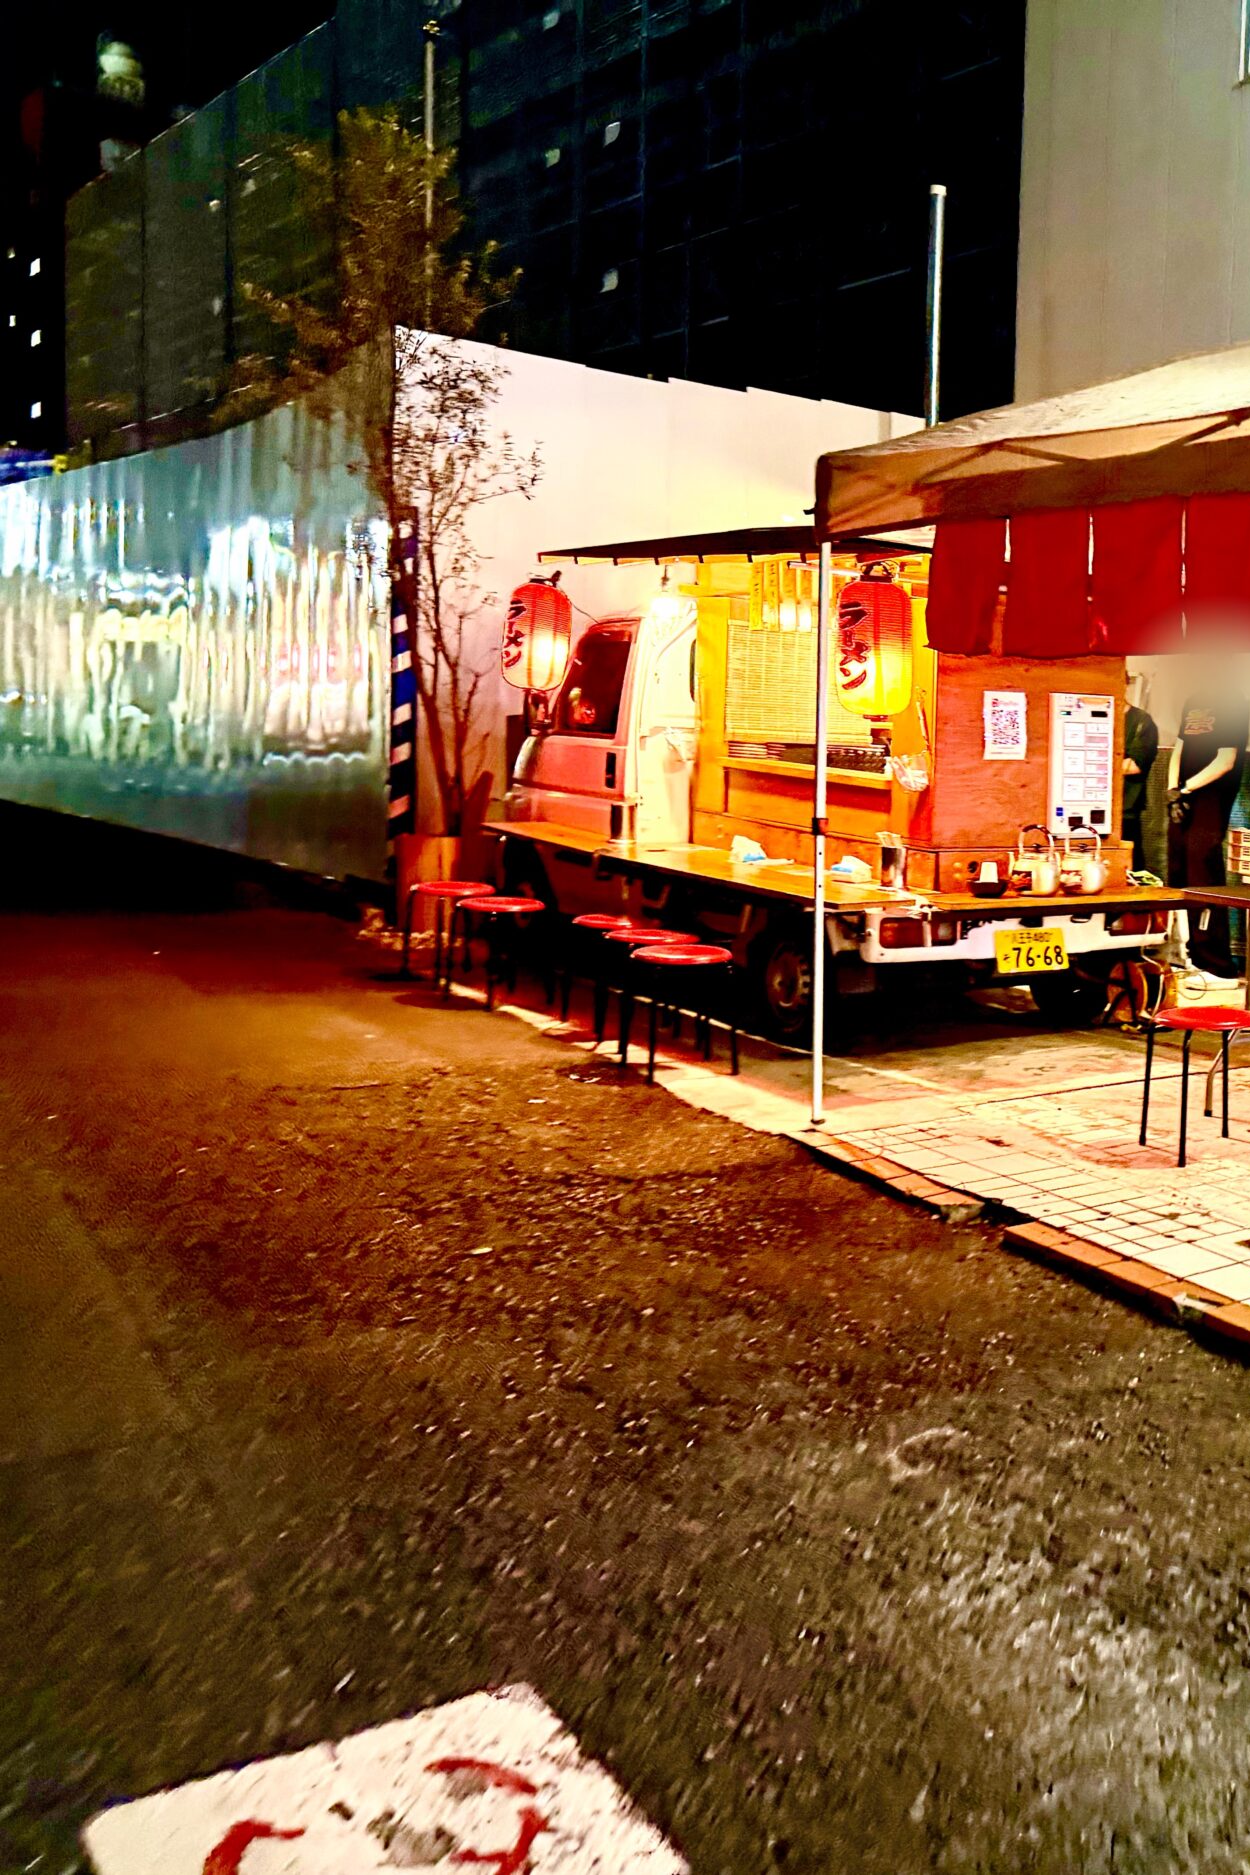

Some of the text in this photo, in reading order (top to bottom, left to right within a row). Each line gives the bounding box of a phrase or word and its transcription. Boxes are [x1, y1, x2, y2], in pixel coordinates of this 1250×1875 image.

[503, 599, 527, 668] ラーメン
[838, 600, 872, 691] ラーメン
